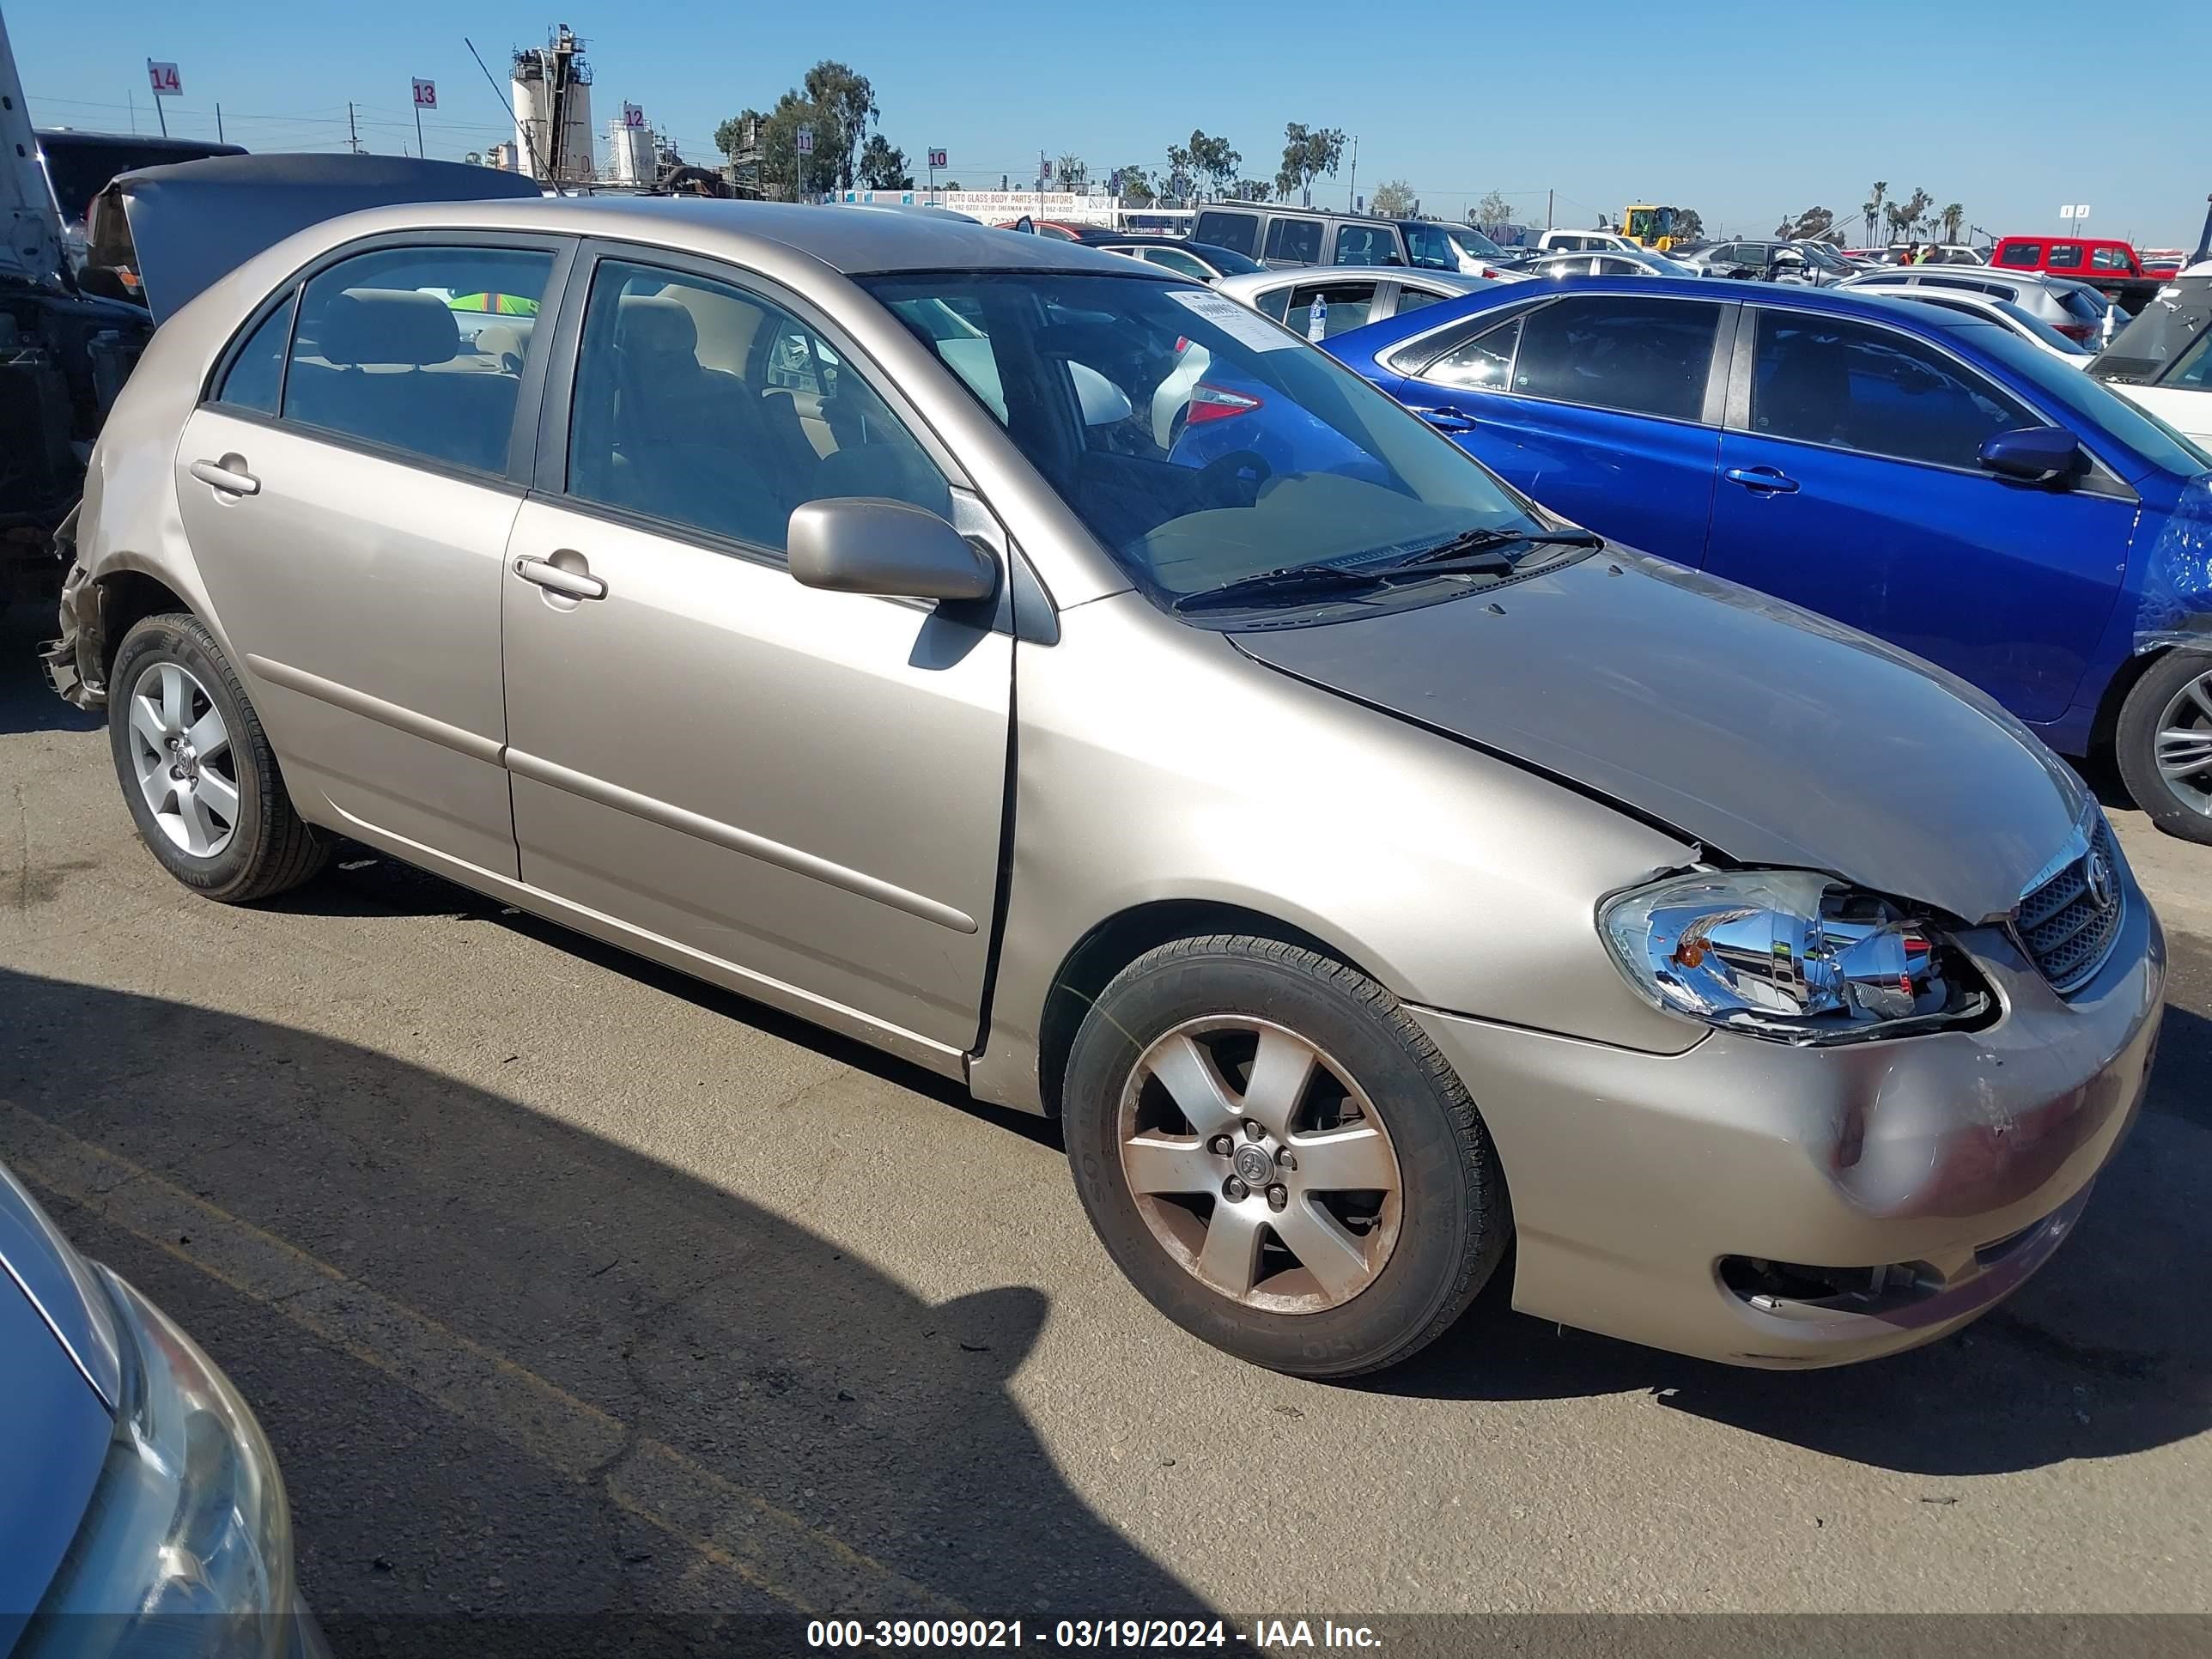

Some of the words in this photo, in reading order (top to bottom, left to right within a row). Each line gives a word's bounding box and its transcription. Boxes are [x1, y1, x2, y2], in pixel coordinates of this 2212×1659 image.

[149, 68, 179, 90] 14
[413, 84, 435, 104] 13
[625, 110, 644, 126] 12
[799, 136, 812, 150] 11
[929, 152, 946, 166] 10
[1043, 162, 1050, 178] 9
[1113, 173, 1119, 187] 8
[948, 193, 965, 203] AUTO
